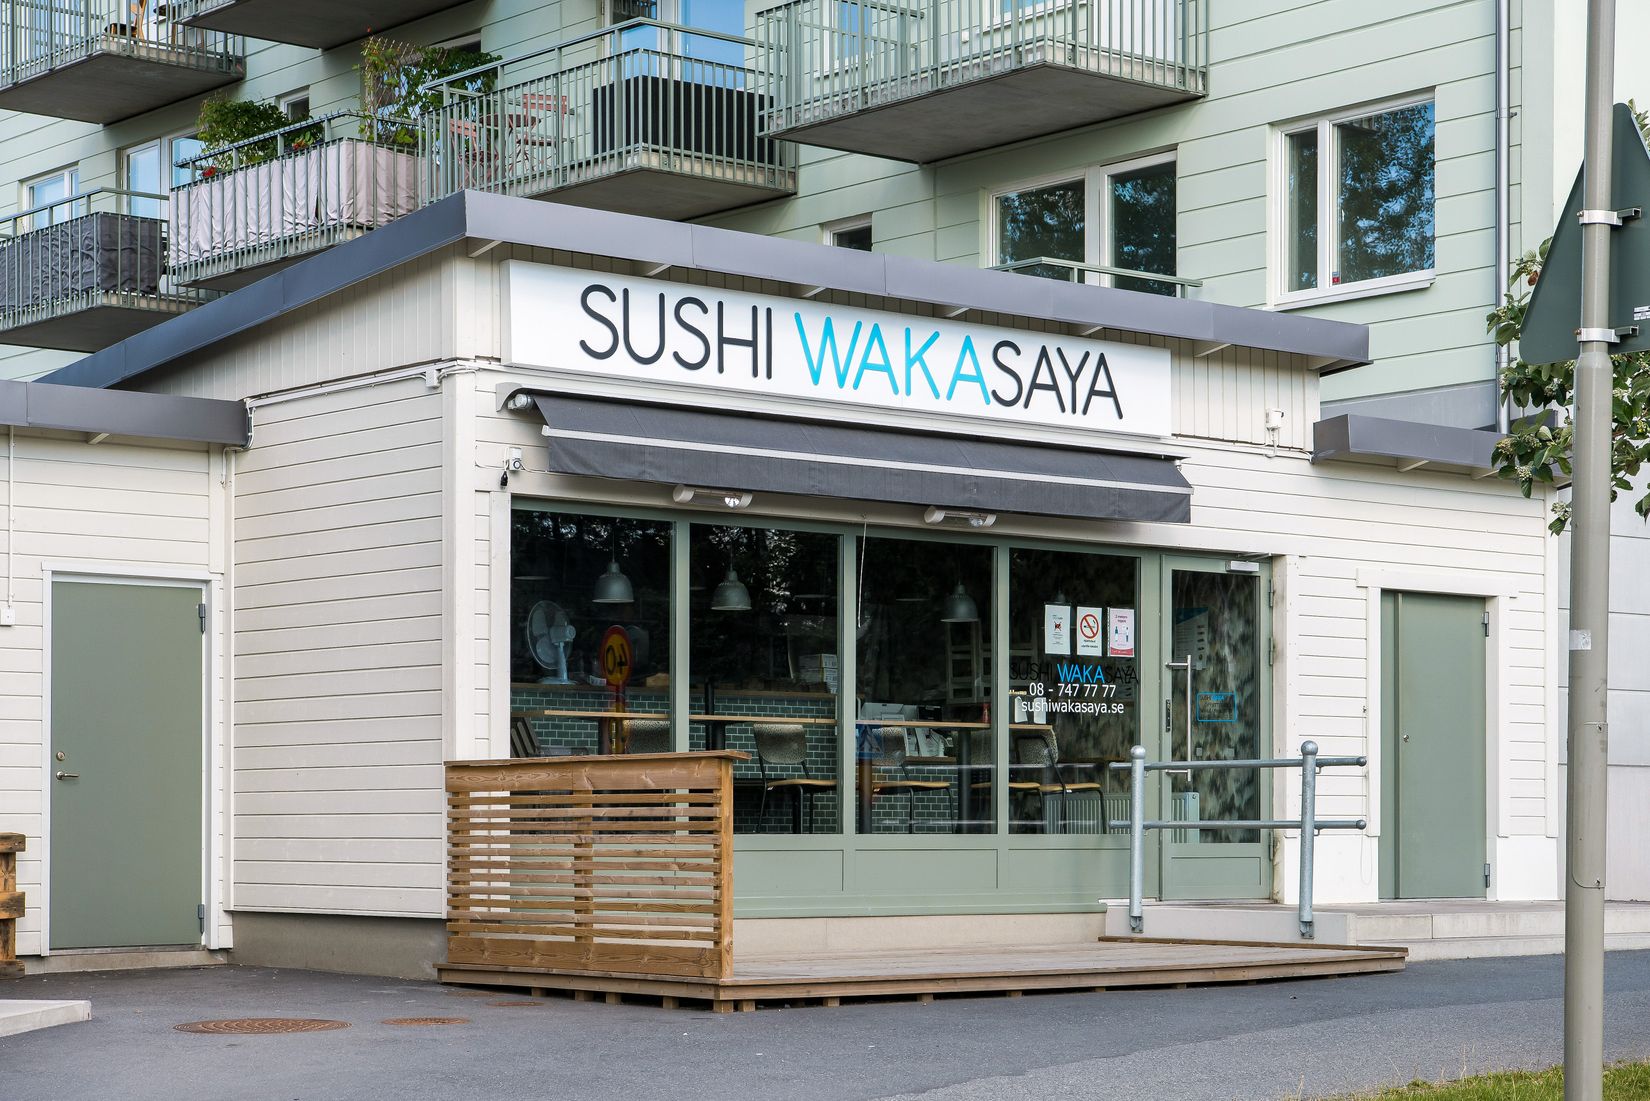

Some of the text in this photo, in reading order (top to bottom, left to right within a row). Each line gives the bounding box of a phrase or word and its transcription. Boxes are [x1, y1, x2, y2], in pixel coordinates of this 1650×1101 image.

[579, 283, 1124, 420] SUSHI WAKASAYA
[1029, 682, 1045, 697] 08
[1057, 683, 1080, 698] 747
[1083, 684, 1098, 698] 77
[1101, 684, 1117, 698] 77
[1021, 698, 1124, 717] sushiwakasaya.se
